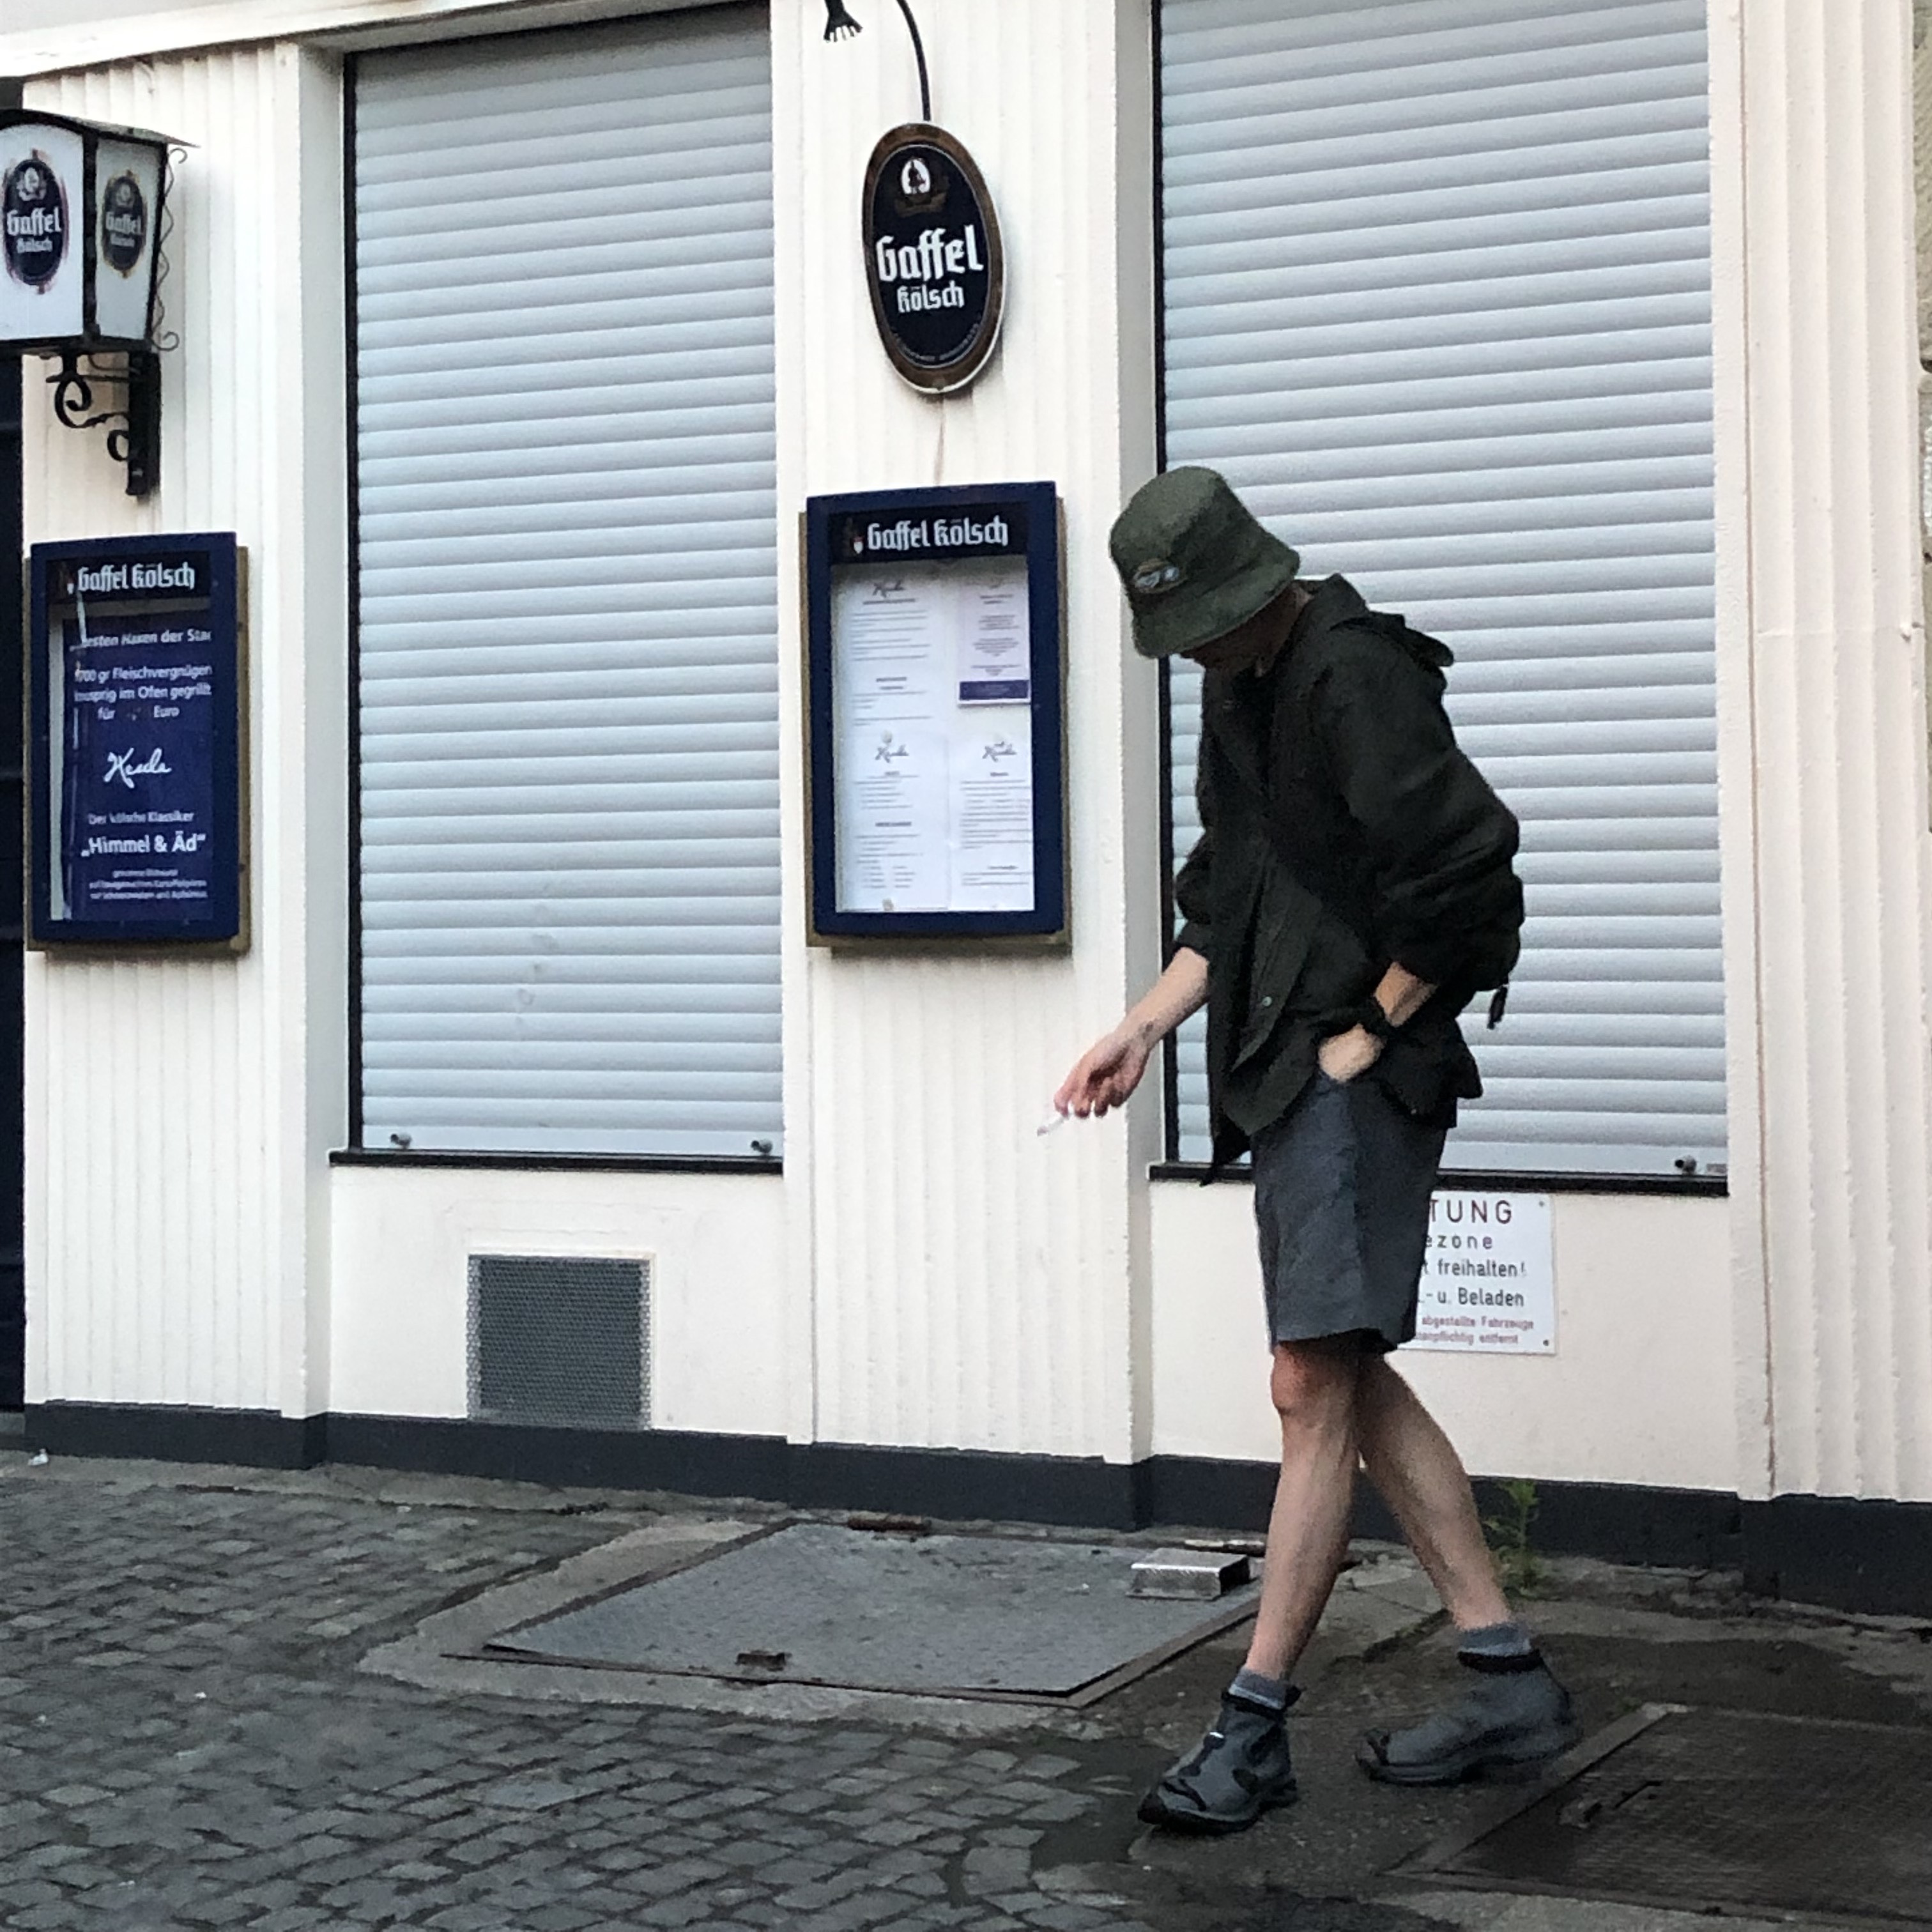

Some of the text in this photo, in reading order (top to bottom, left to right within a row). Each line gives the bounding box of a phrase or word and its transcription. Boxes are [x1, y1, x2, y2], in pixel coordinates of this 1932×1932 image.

[7, 206, 61, 236] Gaffel
[875, 225, 984, 282] Gaffel
[897, 280, 964, 313] Kölsch
[867, 515, 1009, 551] Gaffel Kölsch
[77, 562, 195, 592] Gaffel Kölsch
[161, 630, 183, 643] der
[119, 687, 135, 699] im
[138, 685, 168, 699] Ofen
[97, 705, 180, 720] für Euro
[154, 835, 167, 853] &
[1430, 1199, 1512, 1224] TUNG
[1458, 1287, 1524, 1307] Beladen
